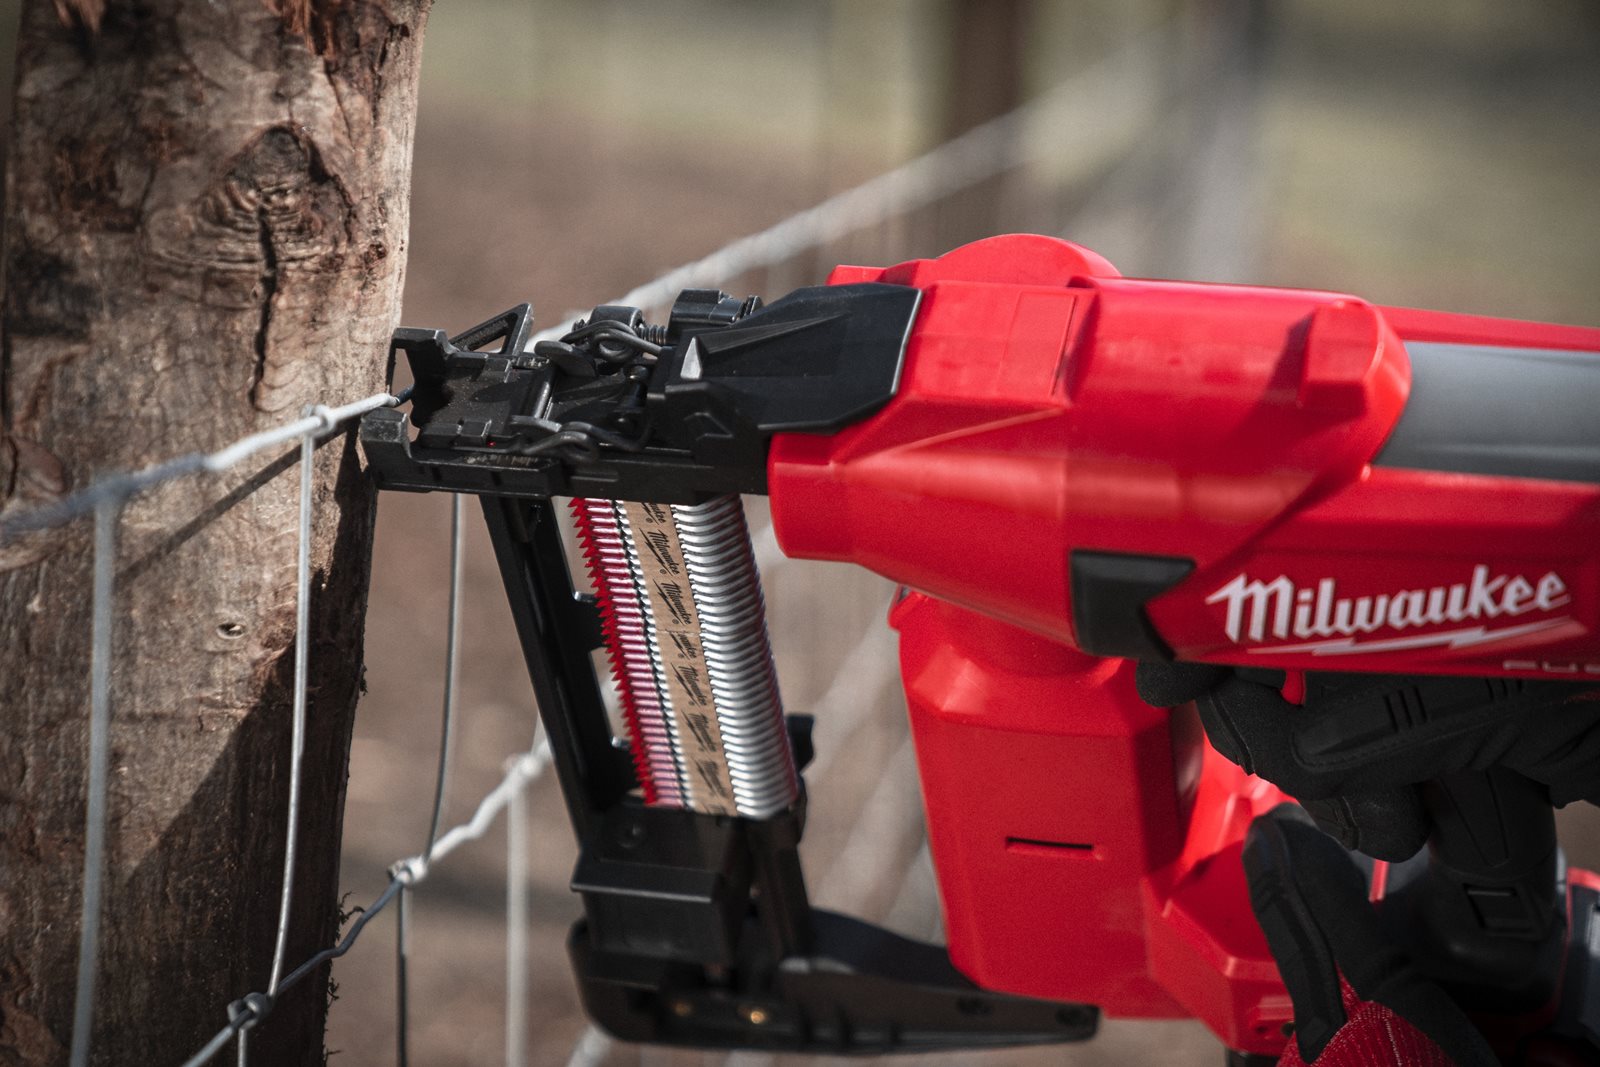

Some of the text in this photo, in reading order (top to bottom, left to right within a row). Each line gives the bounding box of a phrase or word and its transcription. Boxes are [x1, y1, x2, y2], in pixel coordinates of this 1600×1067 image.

[647, 529, 680, 574] Milwaukee
[661, 580, 692, 625] Milwaukee
[1205, 564, 1571, 643] Milwaukee
